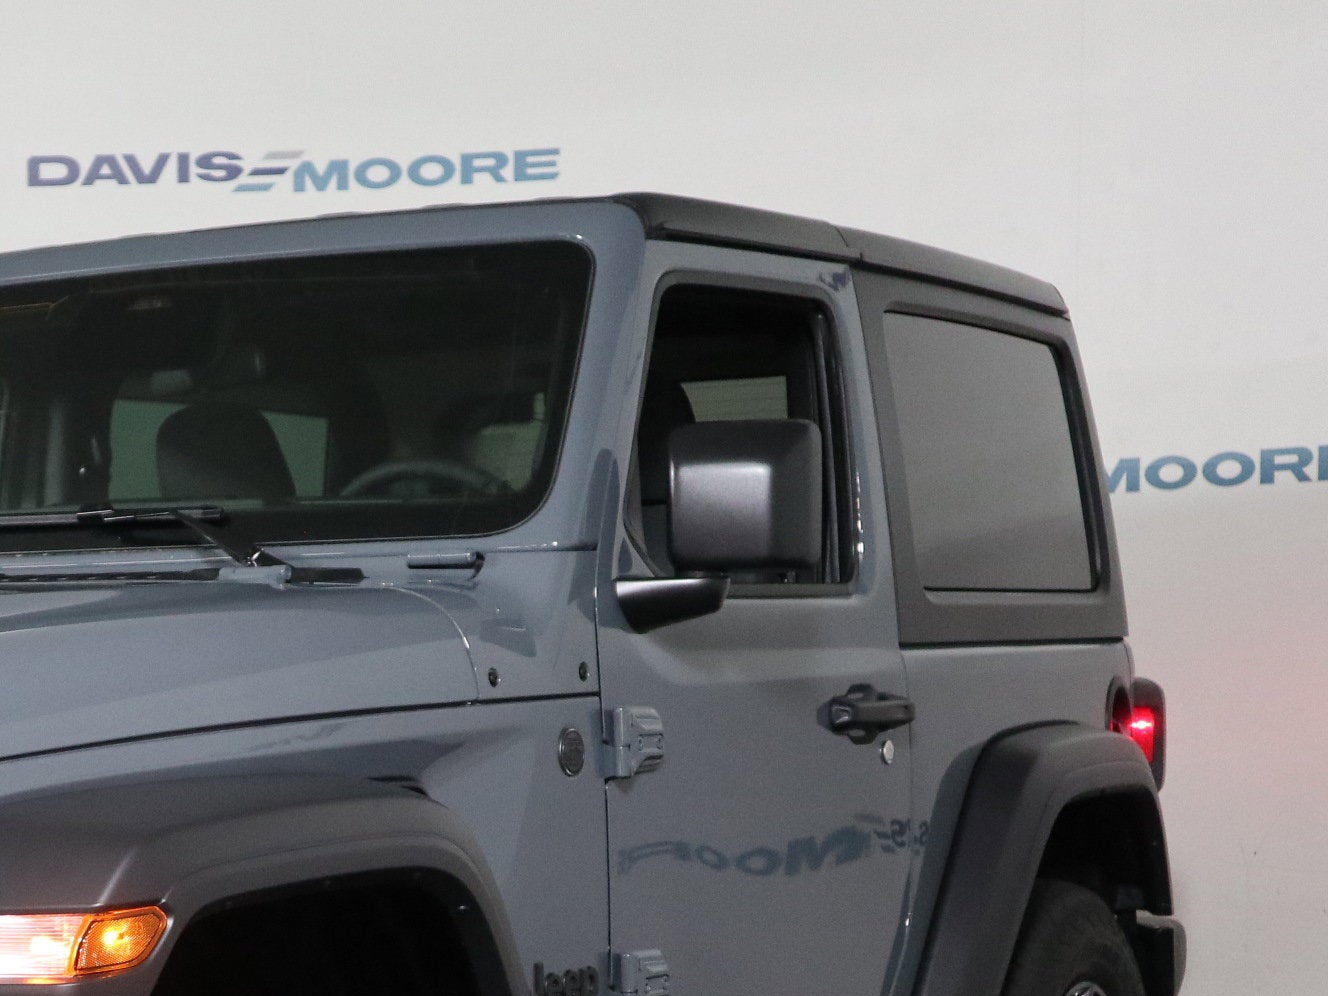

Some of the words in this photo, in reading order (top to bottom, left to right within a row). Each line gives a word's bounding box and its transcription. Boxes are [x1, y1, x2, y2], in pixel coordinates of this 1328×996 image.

[26, 150, 243, 187] DAVIS
[293, 147, 561, 193] MOORE
[1103, 444, 1328, 493] MOOR
